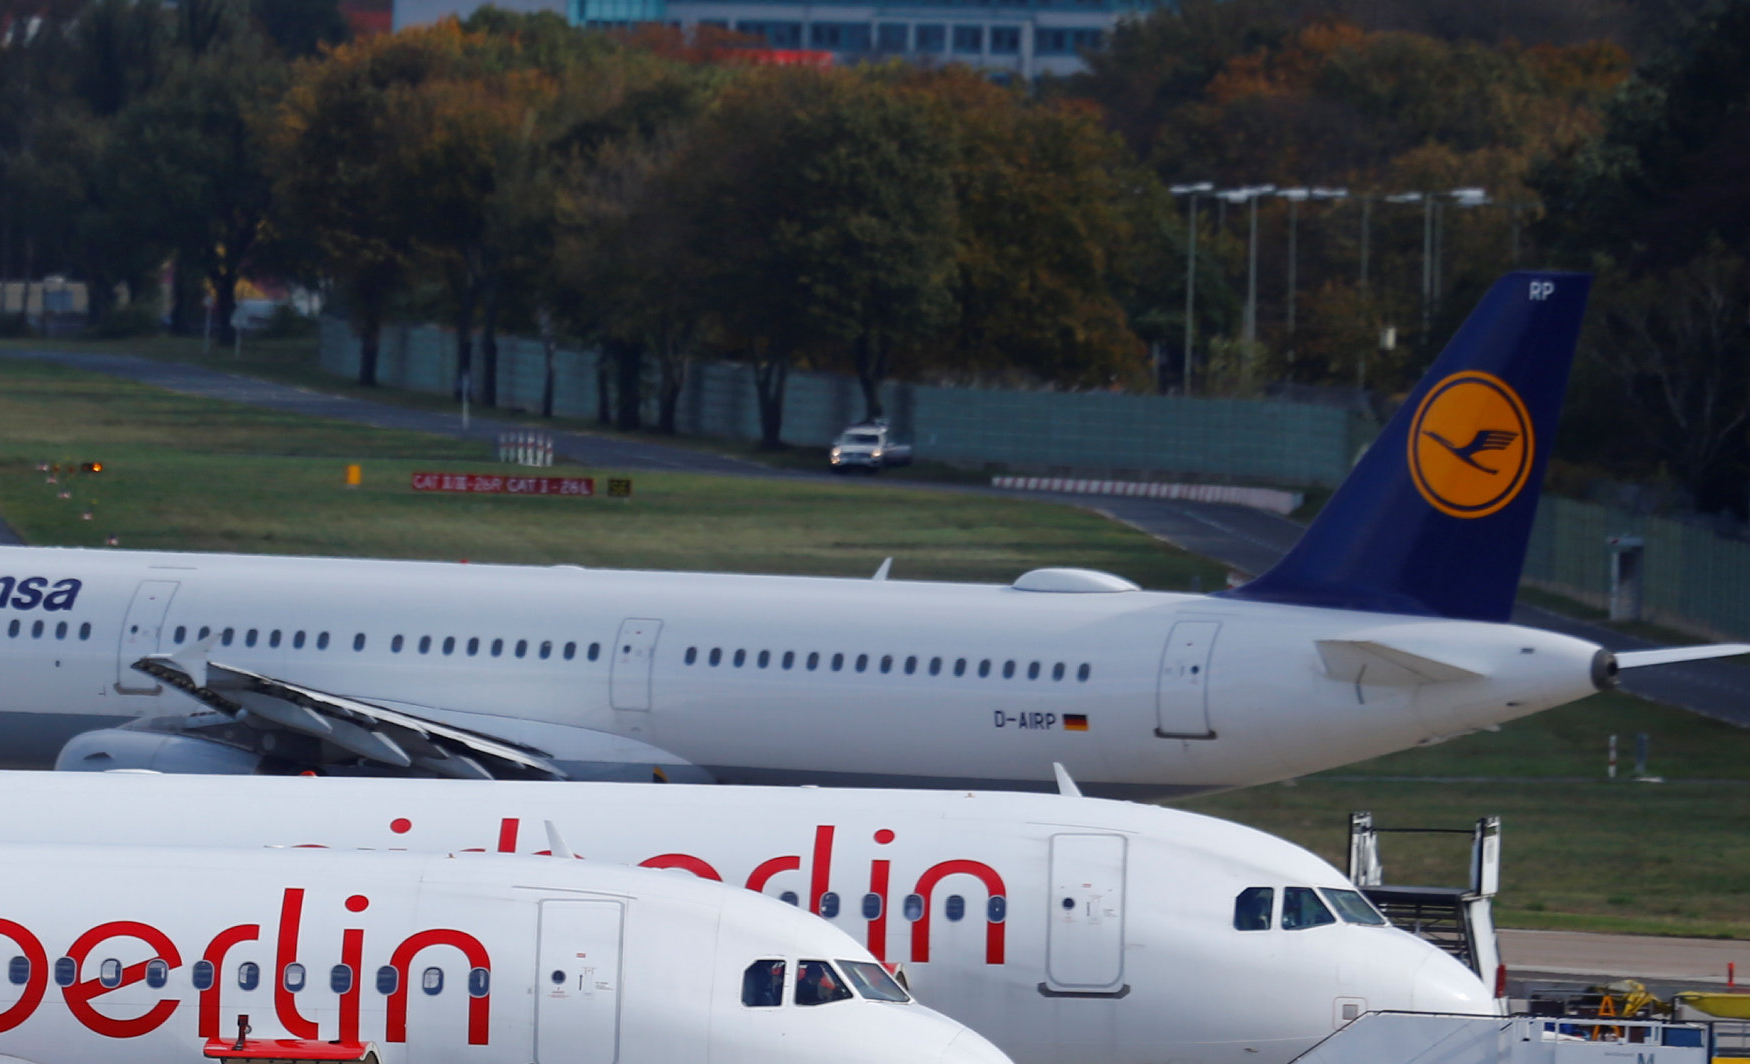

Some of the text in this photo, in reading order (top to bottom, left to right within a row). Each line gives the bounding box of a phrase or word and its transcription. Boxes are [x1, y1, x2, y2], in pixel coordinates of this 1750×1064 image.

[1530, 281, 1554, 300] RP
[413, 474, 439, 489] CAT
[506, 477, 536, 492] CAT
[994, 710, 1056, 729] D-AIRP
